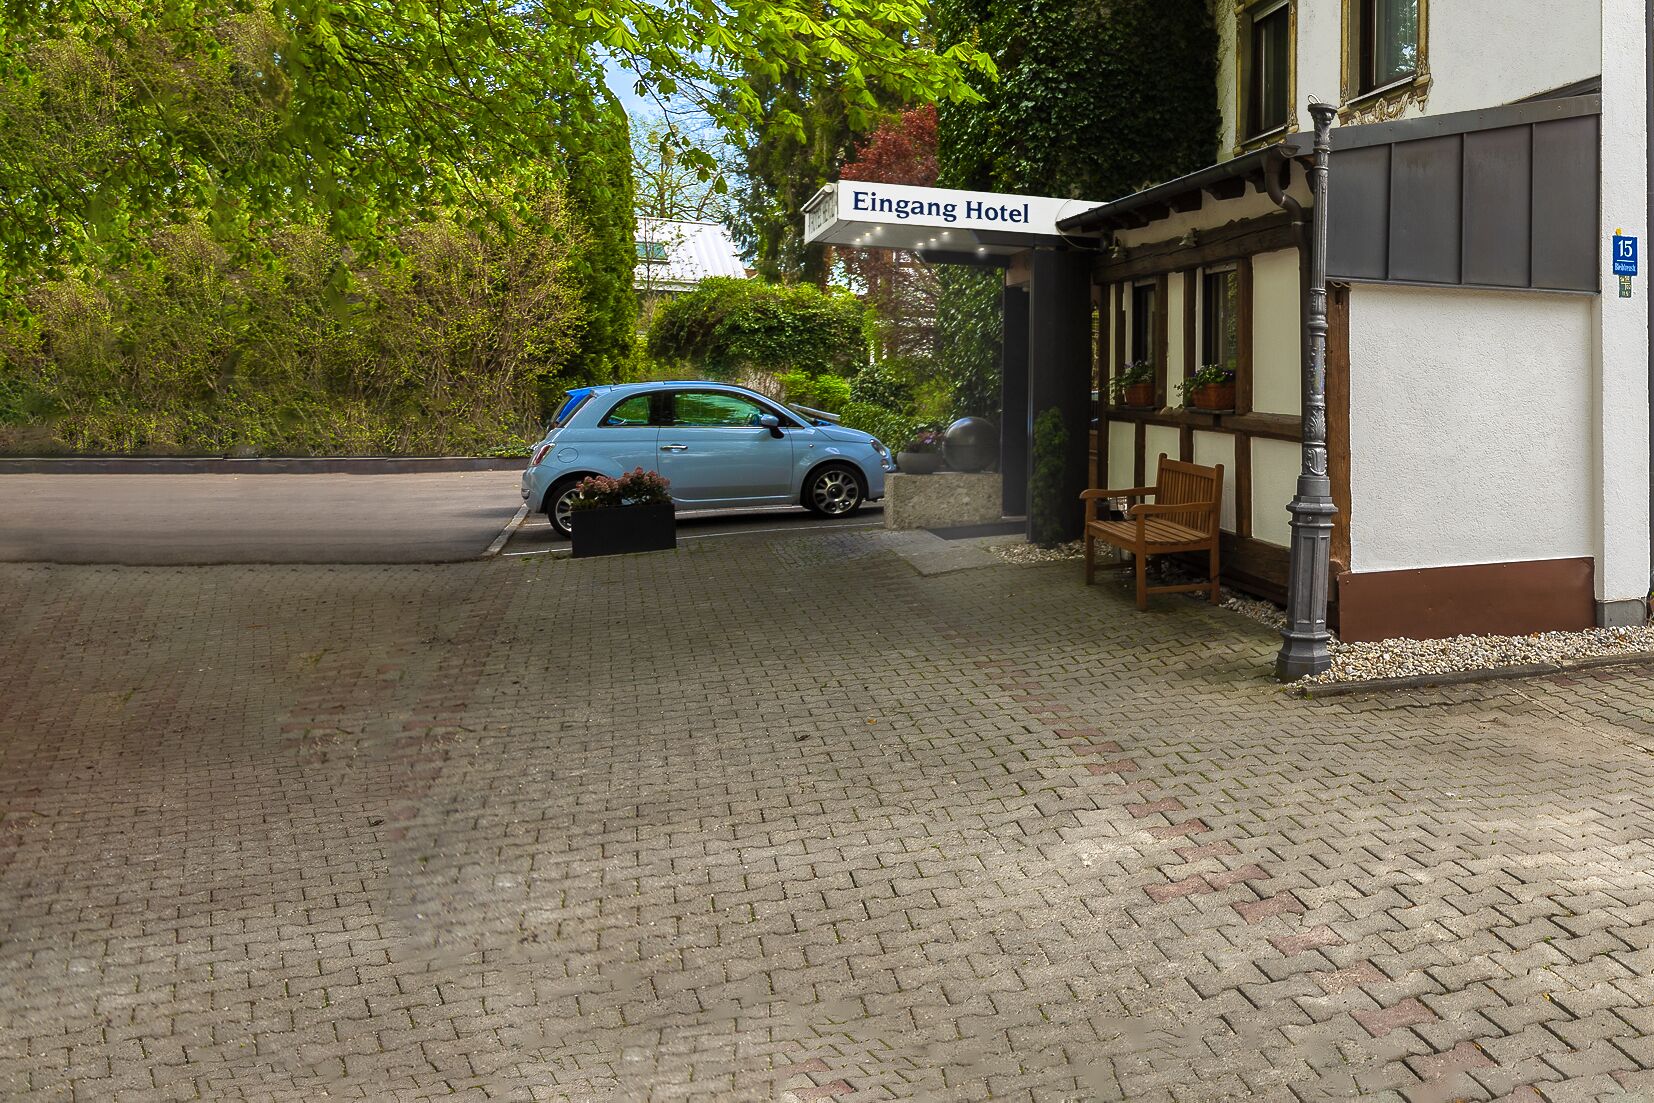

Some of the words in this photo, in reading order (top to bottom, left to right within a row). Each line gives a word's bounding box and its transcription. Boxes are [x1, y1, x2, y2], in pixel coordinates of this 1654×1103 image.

[852, 191, 957, 222] Eingang
[965, 201, 1029, 223] Hotel
[1618, 239, 1633, 257] 15
